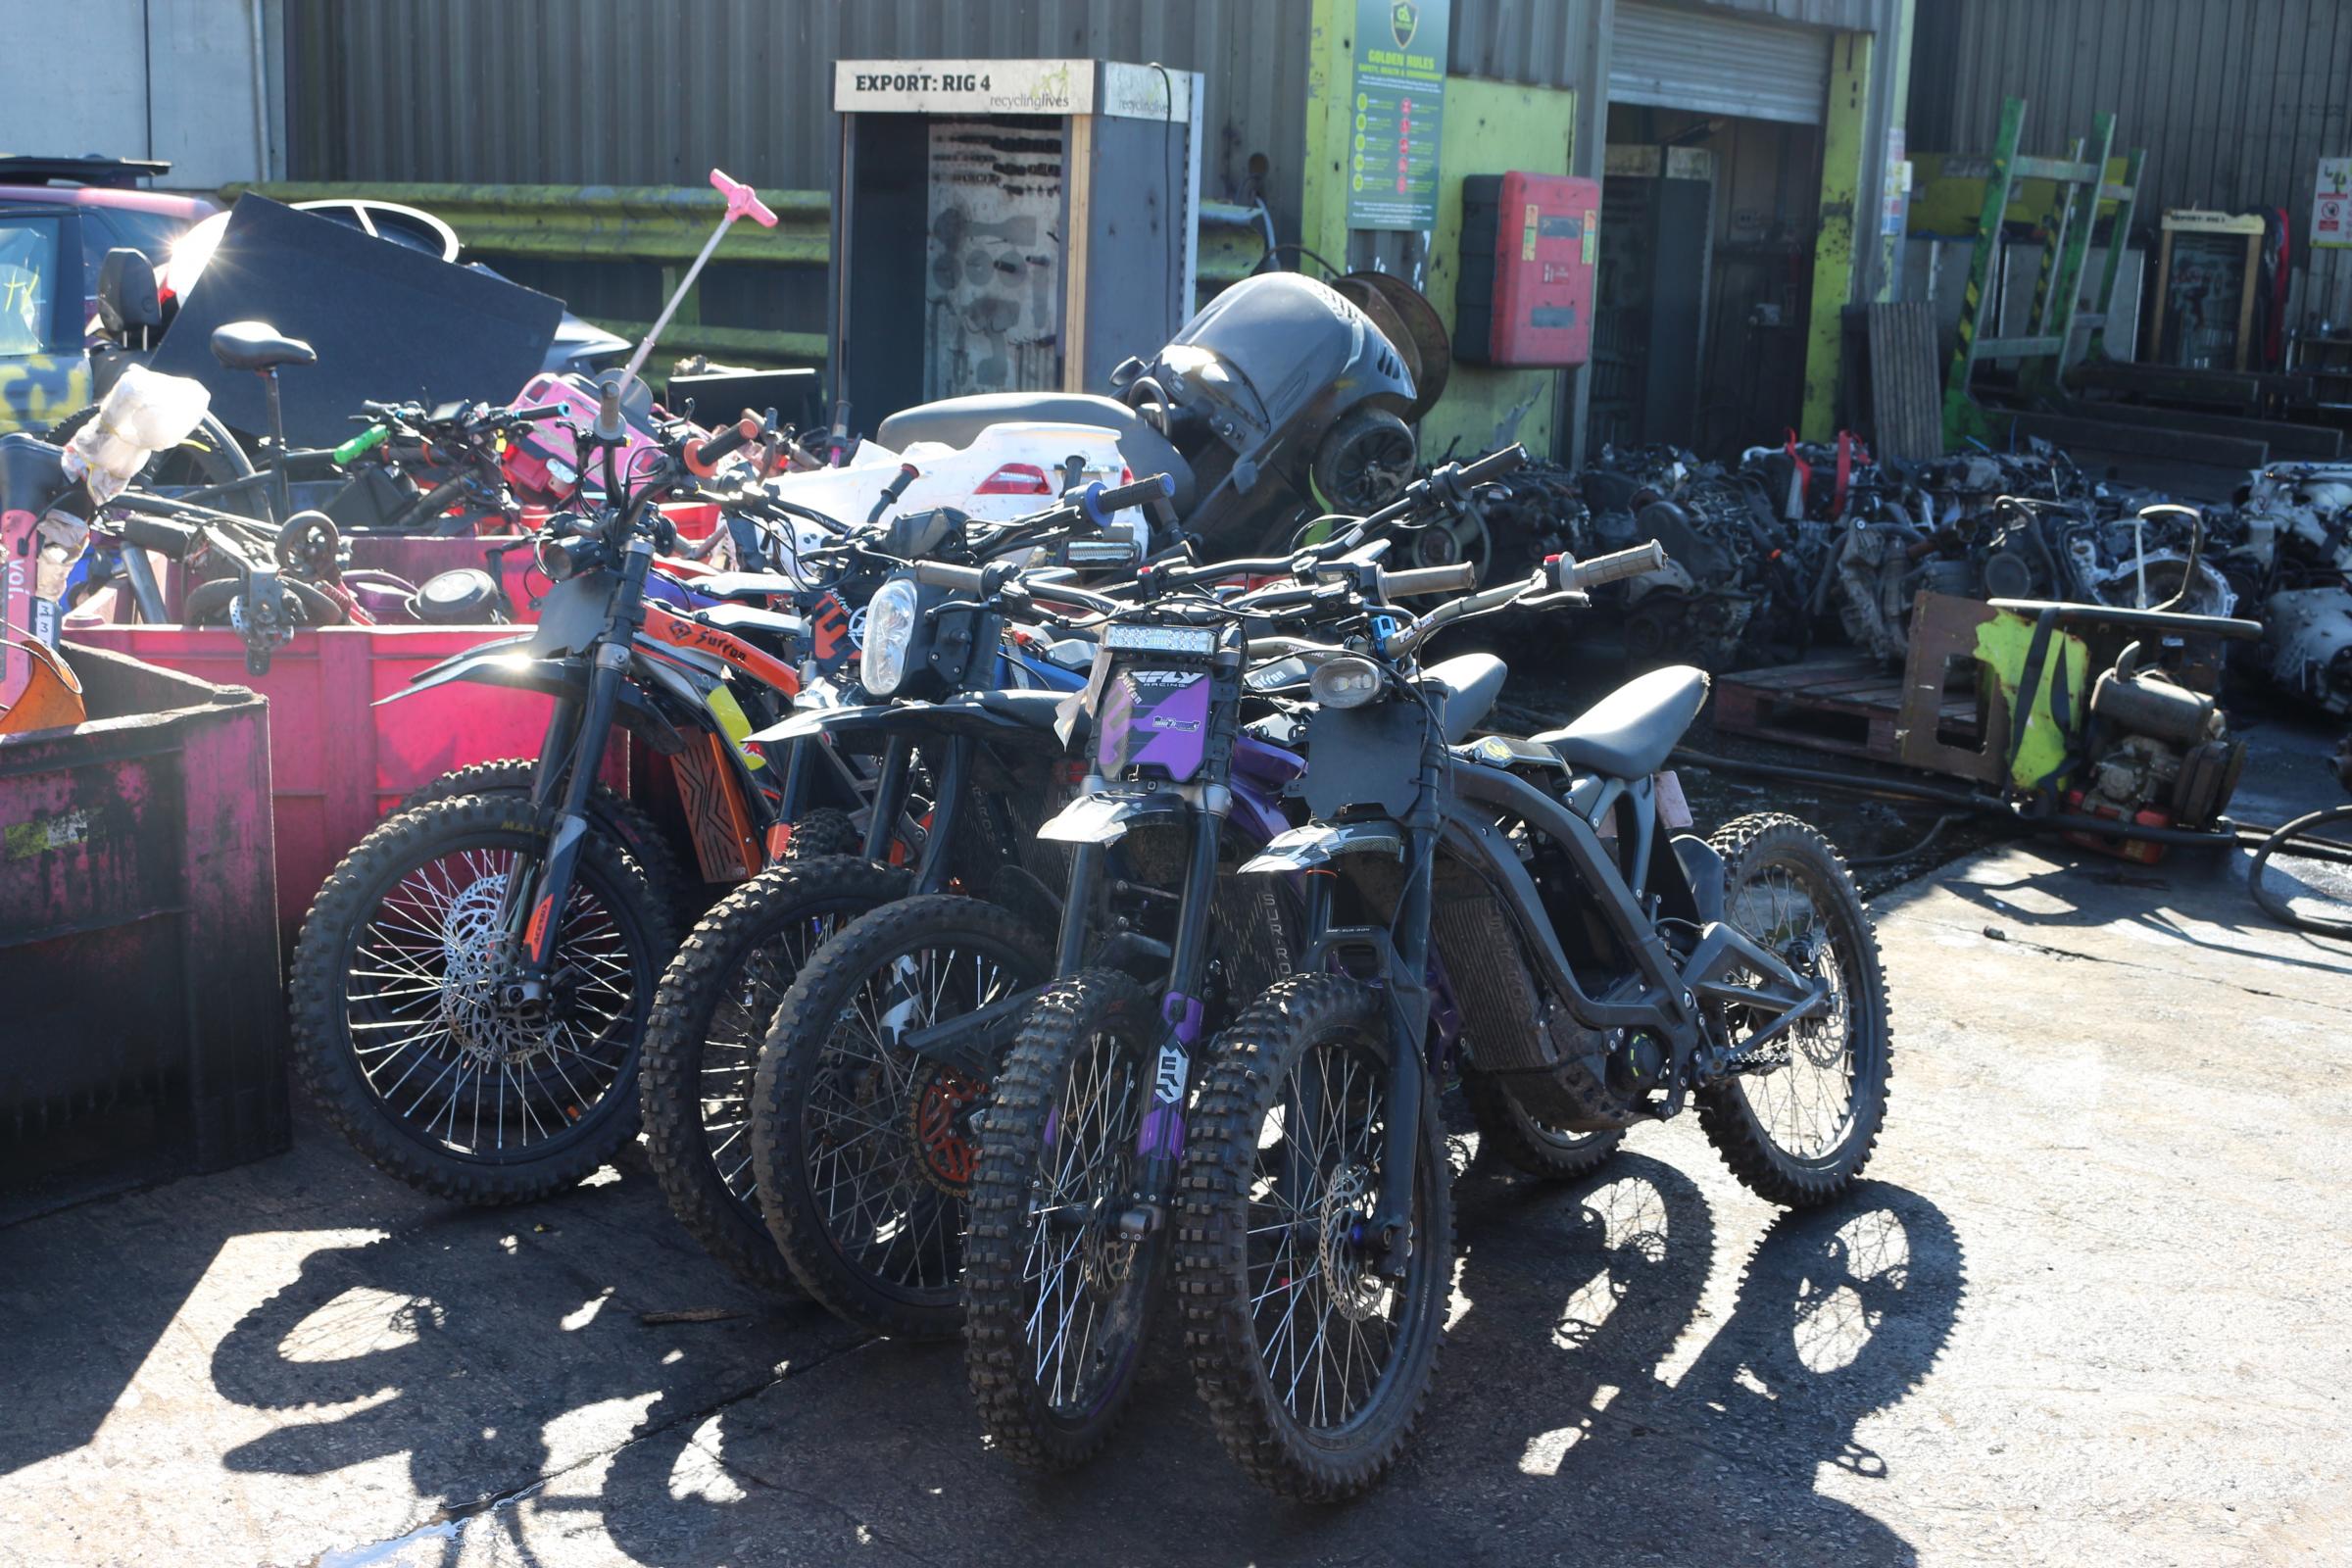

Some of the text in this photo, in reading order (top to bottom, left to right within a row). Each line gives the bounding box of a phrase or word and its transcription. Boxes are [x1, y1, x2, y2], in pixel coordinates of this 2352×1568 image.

[856, 74, 991, 92] EXPORT: RIG 4
[989, 93, 1069, 111] recyclinglives
[1118, 97, 1170, 116] recyclinglive
[8, 560, 30, 600] voi.
[694, 630, 747, 661] Surron
[1116, 671, 1143, 705] Surron
[1130, 671, 1205, 684] FLY
[1261, 893, 1293, 974] SUR-RO
